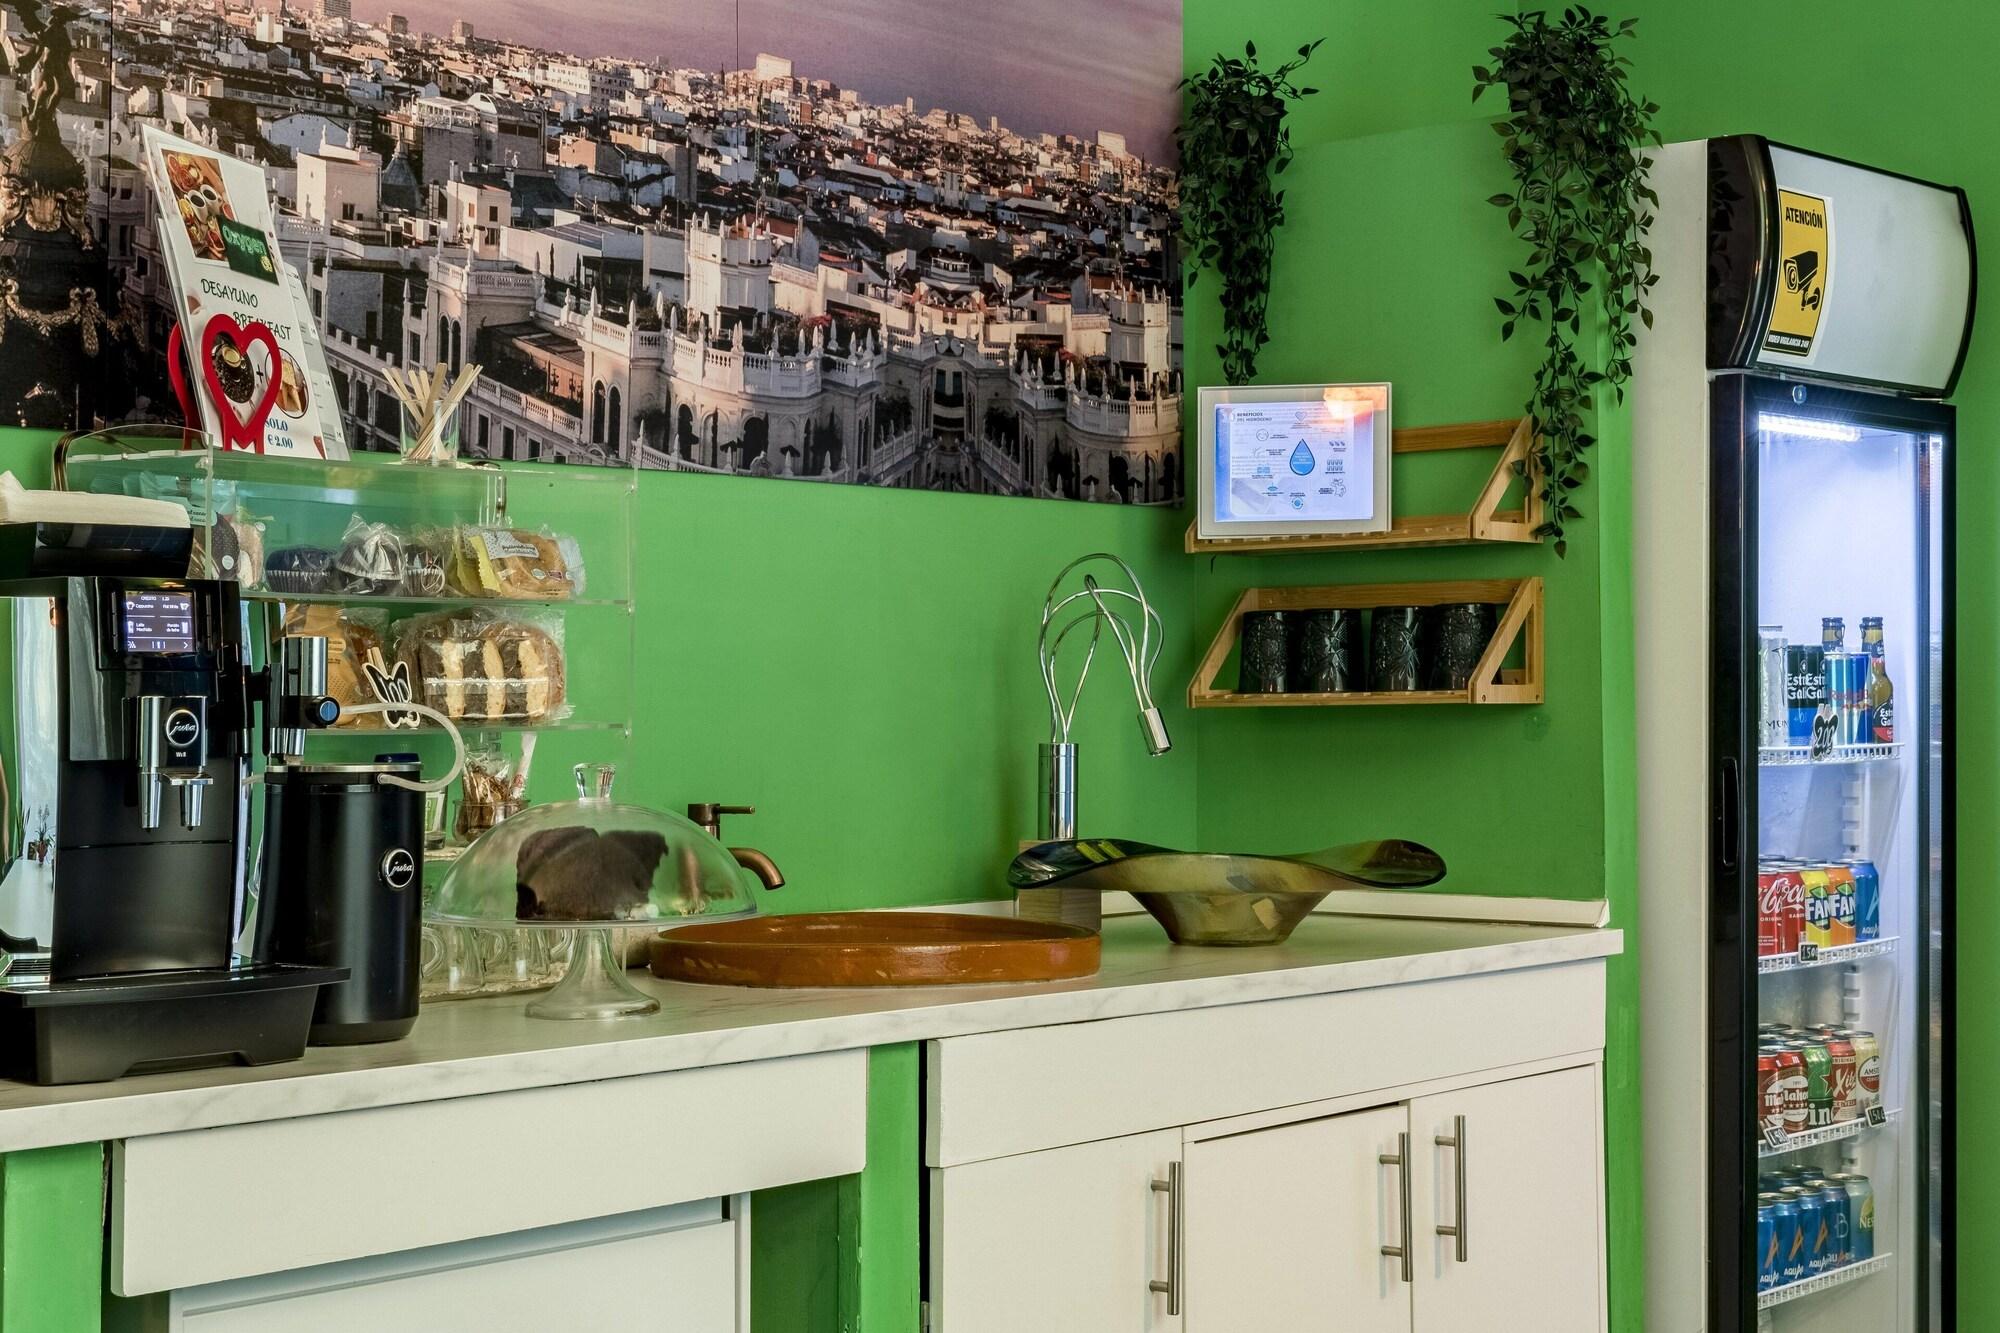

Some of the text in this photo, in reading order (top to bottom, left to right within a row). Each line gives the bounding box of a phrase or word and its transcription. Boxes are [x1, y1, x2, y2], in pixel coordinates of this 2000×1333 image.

[1785, 206, 1823, 229] ATENCIÓN
[201, 278, 258, 308] DESAYUNO
[274, 436, 293, 449] 2.00
[169, 721, 196, 736] jura
[386, 861, 413, 878] jura
